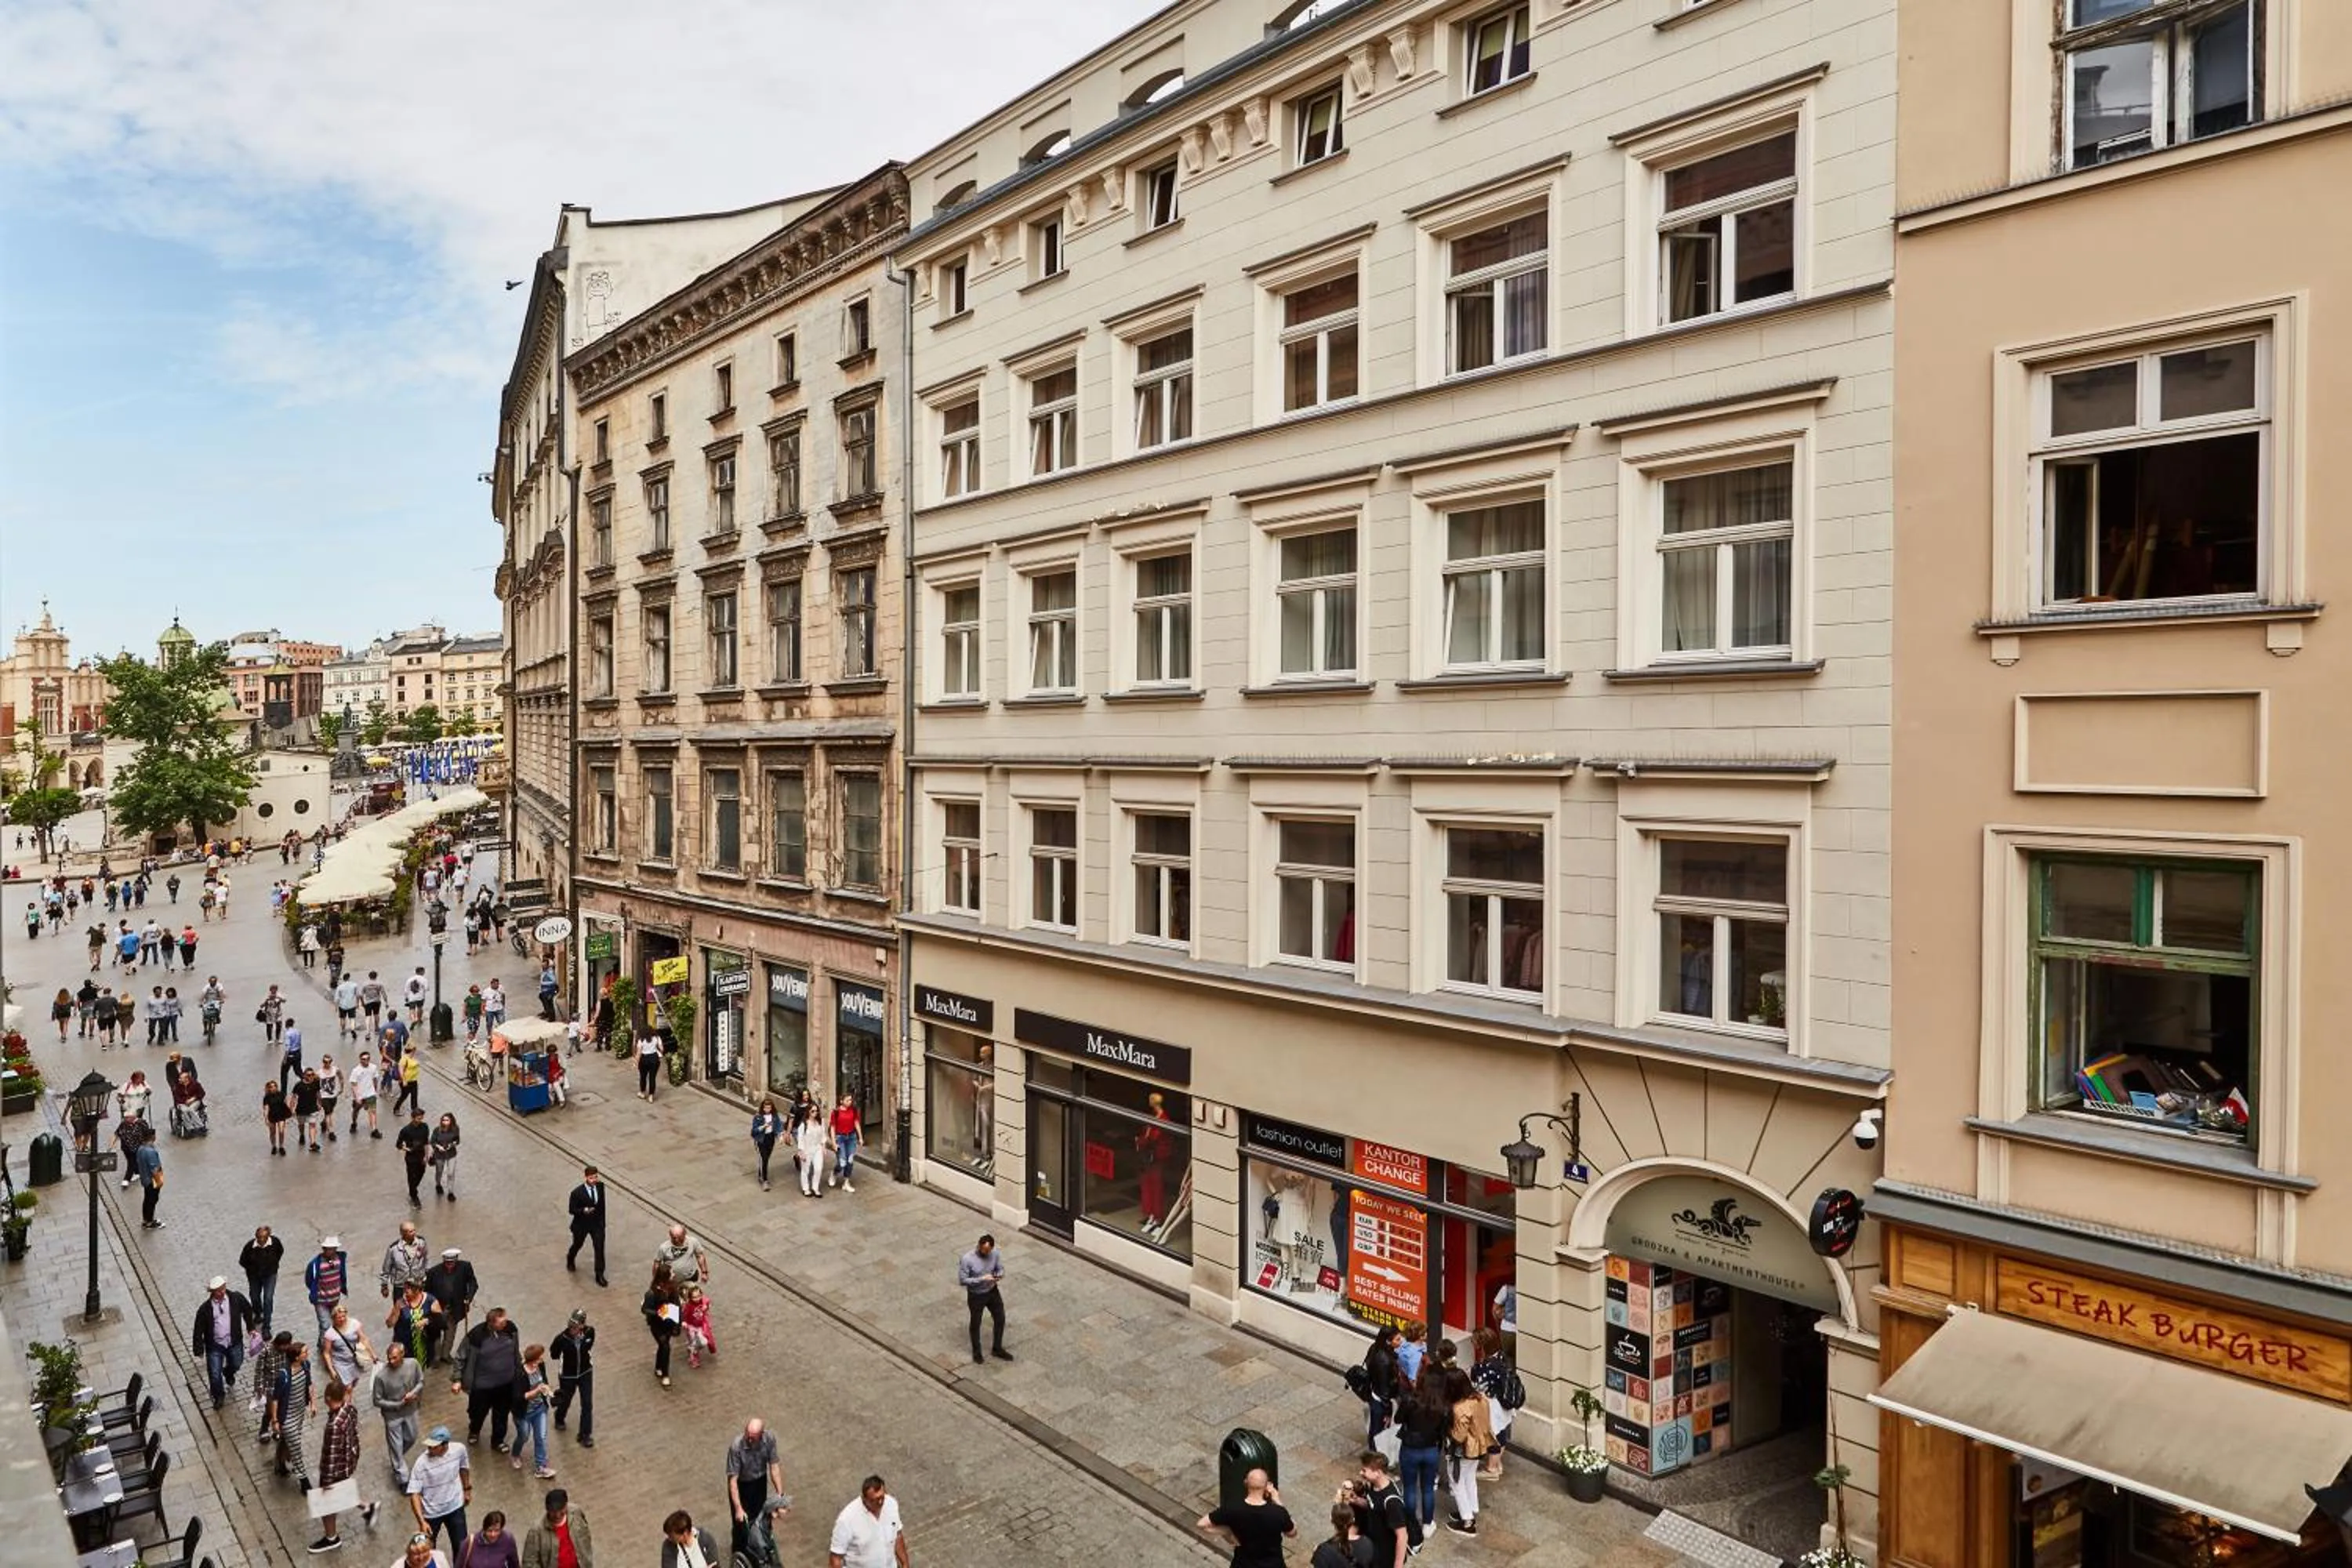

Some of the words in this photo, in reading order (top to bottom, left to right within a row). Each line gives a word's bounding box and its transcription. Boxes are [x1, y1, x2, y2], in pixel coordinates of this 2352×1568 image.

[539, 923, 568, 937] INNA
[925, 993, 977, 1022] MaxMara
[1087, 1033, 1156, 1069] MaxMara
[1257, 1123, 1302, 1148] fashion
[1304, 1139, 1343, 1160] outlet
[1364, 1143, 1421, 1169] KANTOR
[1364, 1160, 1421, 1185] CHANGE
[1572, 1164, 1579, 1175] 4
[1355, 1196, 1384, 1210] TODAY
[1385, 1203, 1402, 1216] WE
[1294, 1231, 1325, 1251] SALE
[1631, 1236, 1677, 1255] GRODZKA
[1354, 1274, 1378, 1290] BEST
[1379, 1283, 1421, 1305] SELLING
[1355, 1285, 1385, 1302] RATES
[1387, 1297, 1418, 1315] INSIDE
[1349, 1301, 1392, 1320] WESTERN
[1362, 1311, 1392, 1327] UNION
[2027, 1279, 2138, 1328] STEAK
[2149, 1312, 2310, 1372] BURGER
